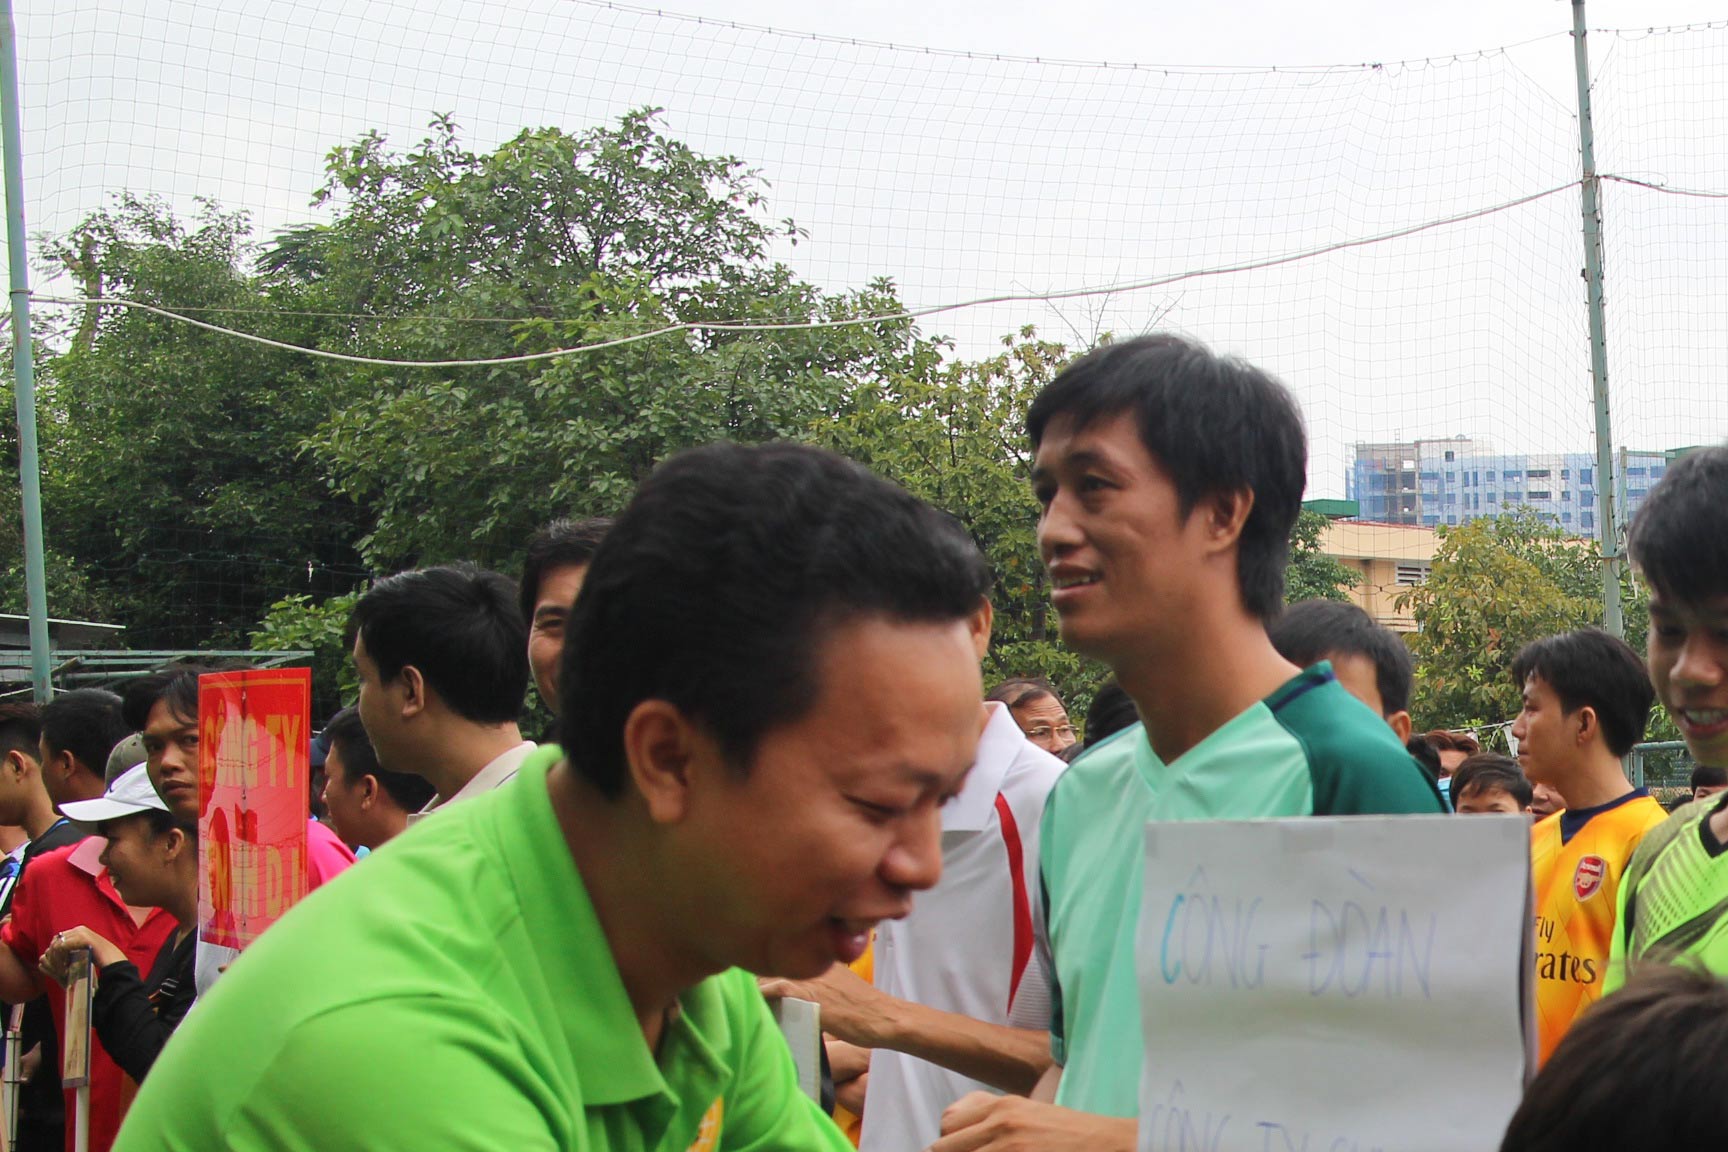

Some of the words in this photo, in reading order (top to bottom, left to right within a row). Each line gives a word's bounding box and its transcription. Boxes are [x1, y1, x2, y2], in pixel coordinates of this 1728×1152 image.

[265, 714, 301, 788] TY
[1160, 864, 1270, 990] CÔNG
[1301, 867, 1436, 1001] ĐOÀN
[1535, 951, 1597, 984] rates
